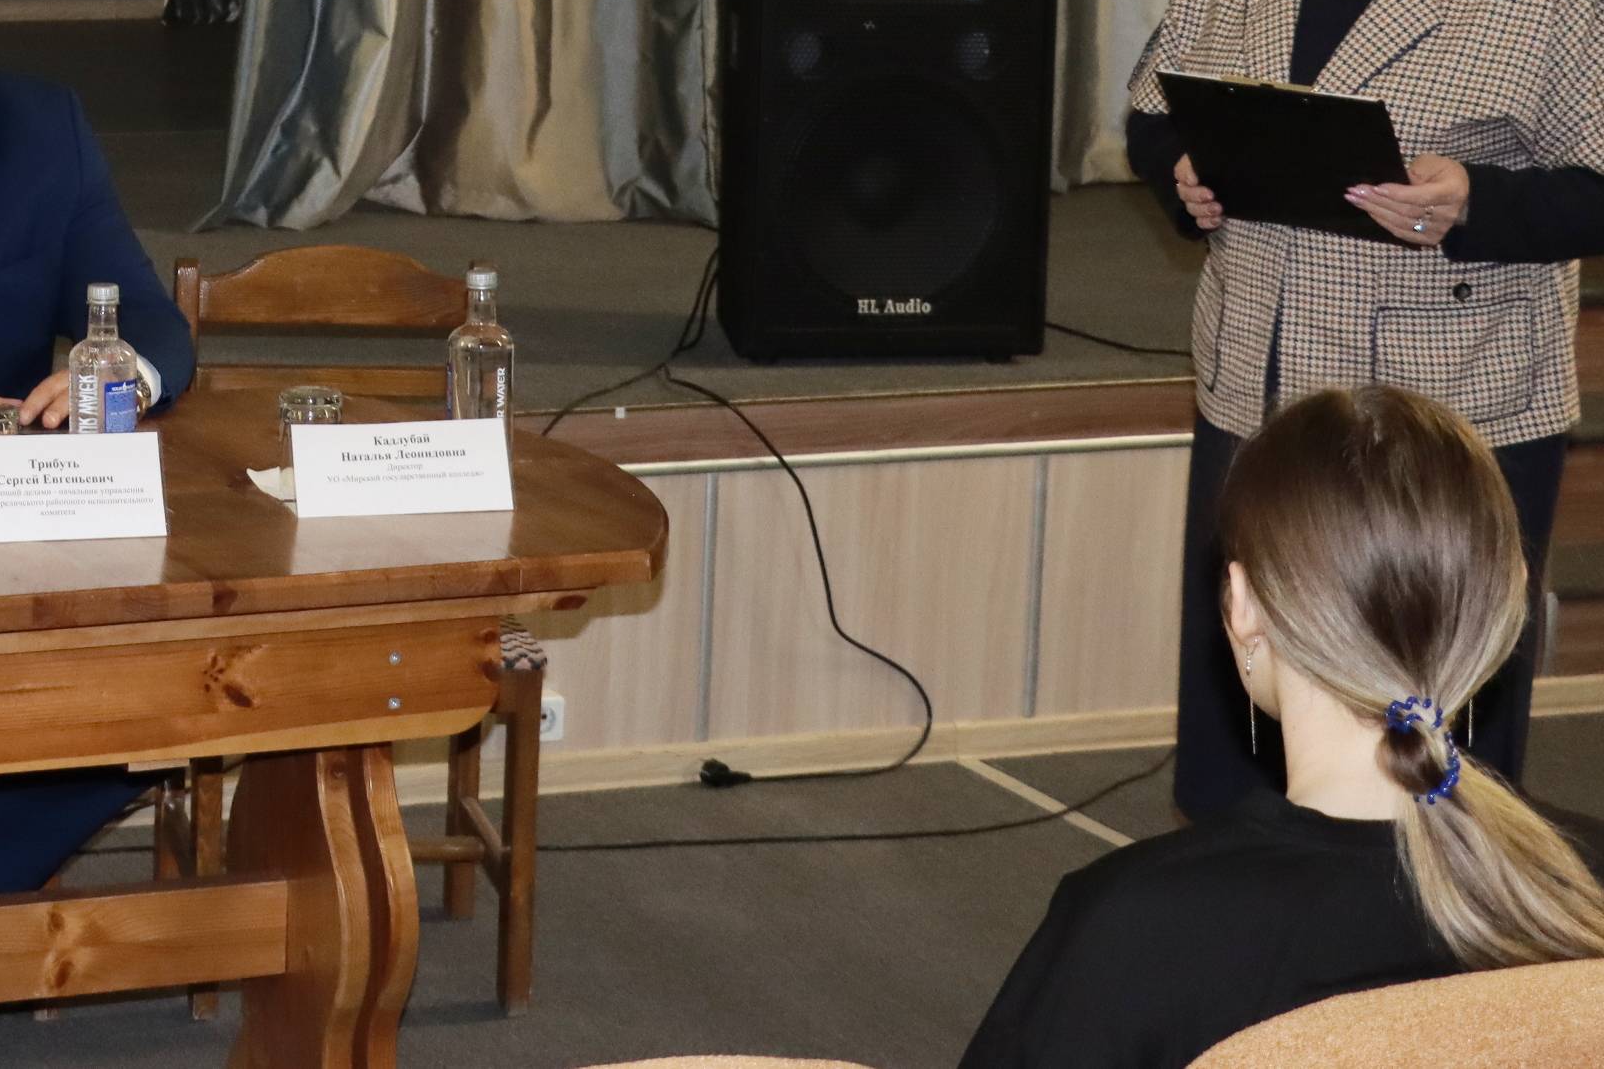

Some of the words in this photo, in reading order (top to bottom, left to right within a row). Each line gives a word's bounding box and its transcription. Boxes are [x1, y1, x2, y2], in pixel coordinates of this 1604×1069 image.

[858, 299, 879, 313] HL
[884, 298, 931, 313] Audio
[497, 368, 506, 407] WATER
[373, 433, 430, 449] Кадлубай
[341, 450, 391, 463] Наталья
[395, 448, 466, 460] Леонидовна
[28, 458, 80, 472] Трибуть
[43, 473, 114, 485] Евгеньевич
